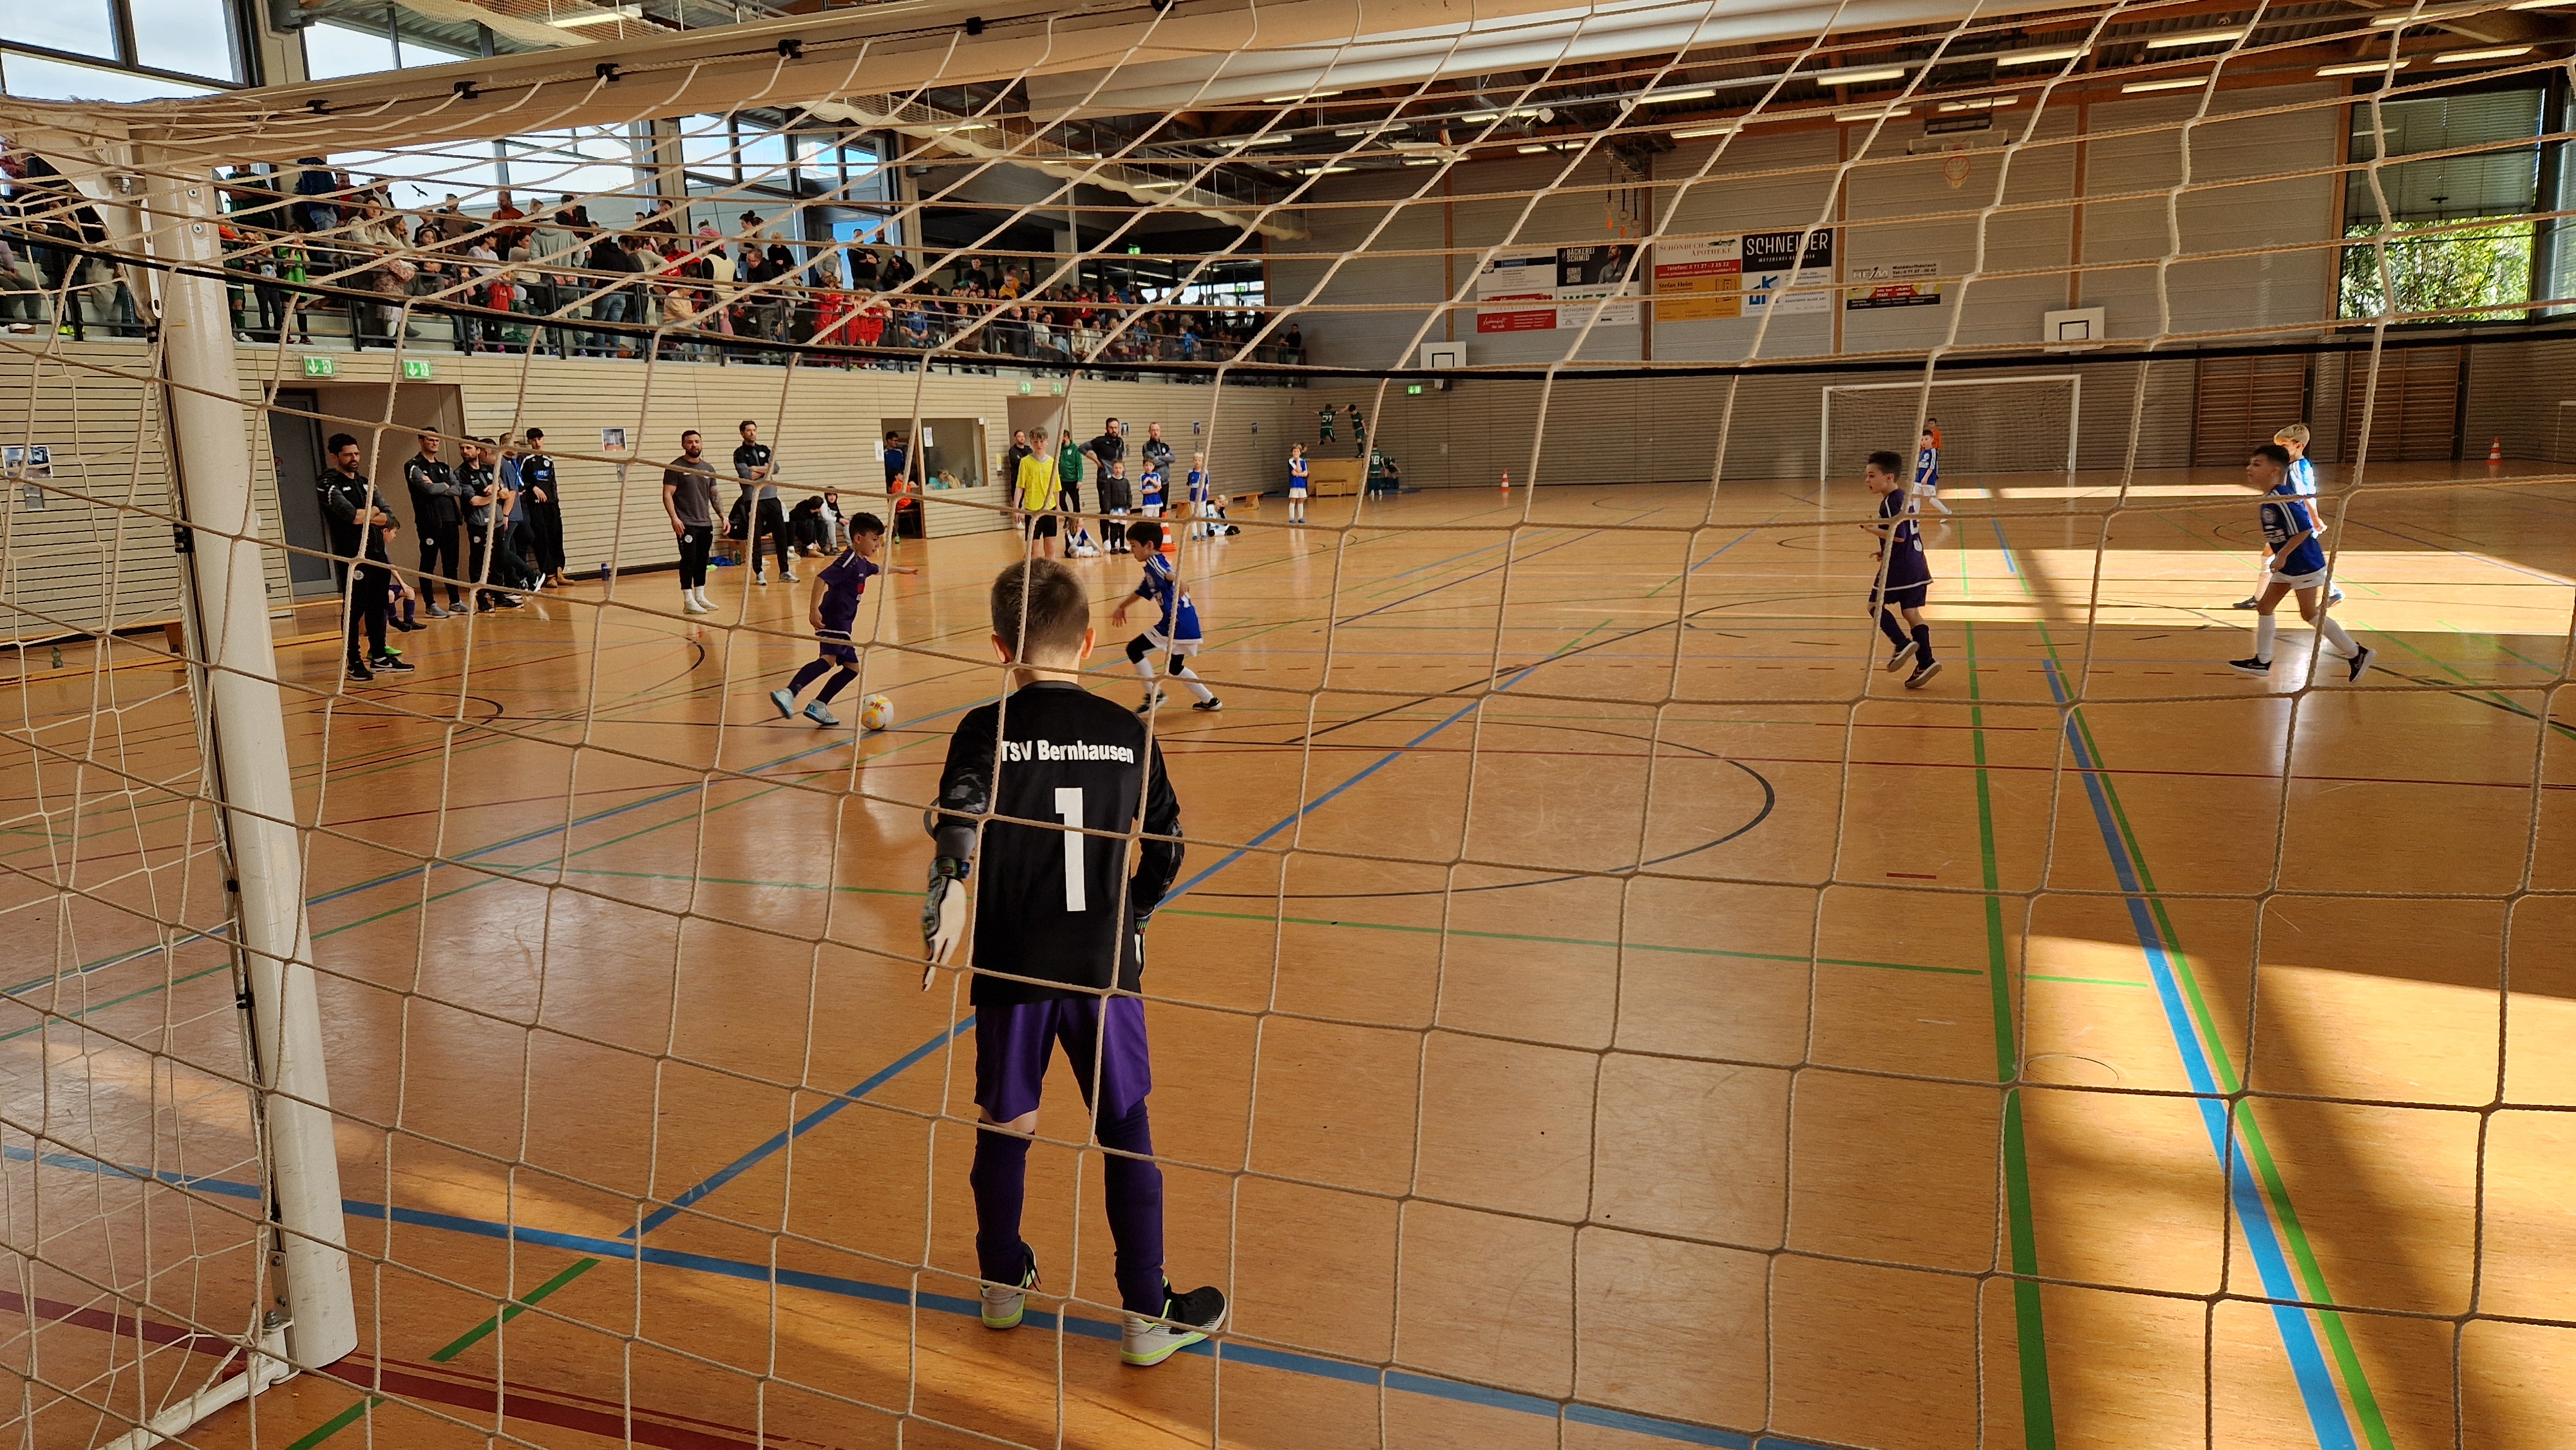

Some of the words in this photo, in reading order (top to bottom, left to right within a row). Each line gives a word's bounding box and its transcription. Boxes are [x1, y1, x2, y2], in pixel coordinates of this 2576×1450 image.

[1371, 455, 1380, 465] 18
[1000, 740, 1032, 762] TSV
[1037, 740, 1134, 764] Bernhausen
[1055, 787, 1086, 912] 1
